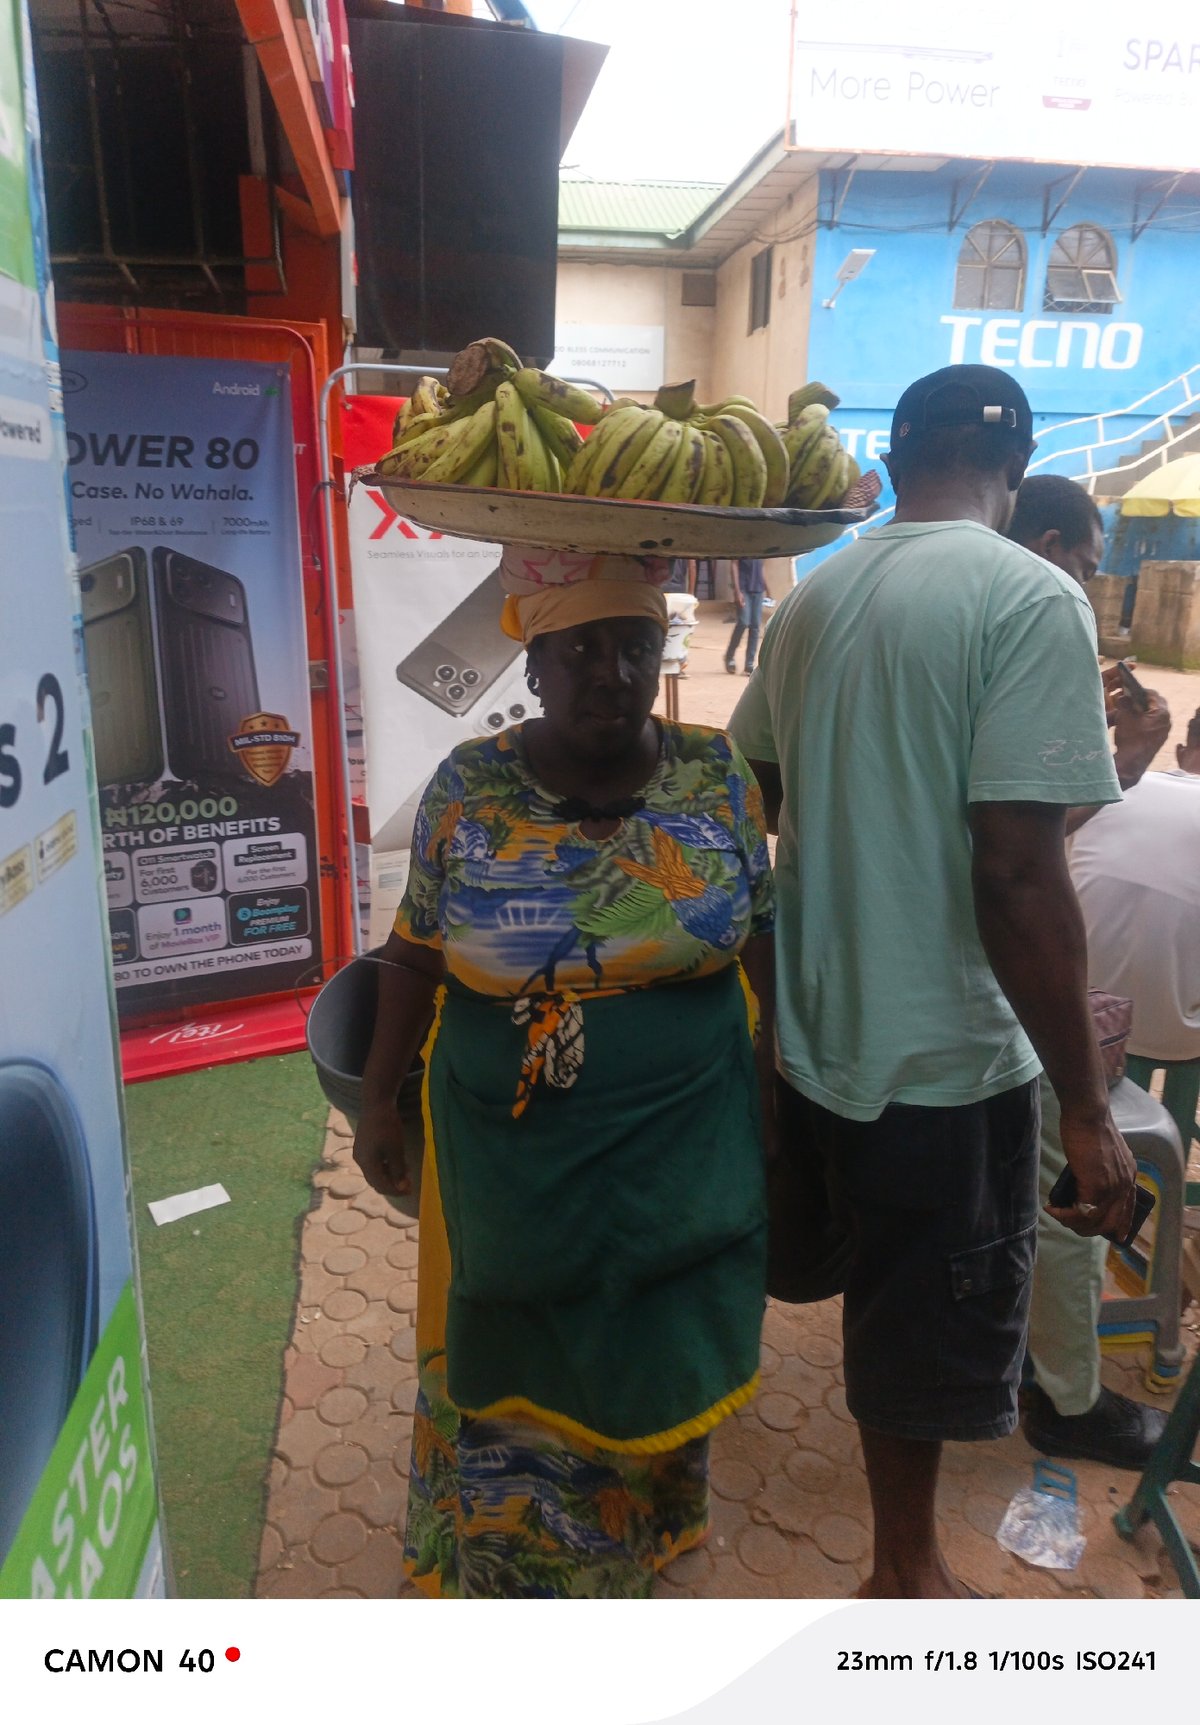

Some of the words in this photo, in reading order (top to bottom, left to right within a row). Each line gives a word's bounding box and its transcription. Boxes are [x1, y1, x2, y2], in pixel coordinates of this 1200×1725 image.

[810, 67, 891, 101] More
[907, 71, 1000, 108] Power
[940, 315, 1143, 369] TECNO
[212, 382, 260, 397] Android
[205, 437, 260, 470] 80
[72, 481, 128, 500] Case.
[135, 482, 164, 501] No
[171, 483, 254, 502] Wahala.
[130, 516, 156, 526] IP68
[158, 516, 167, 526] &
[169, 516, 184, 526] 69
[367, 550, 416, 559] Seamless
[417, 550, 450, 559] Visuals
[452, 550, 465, 559] for
[468, 551, 480, 559] an
[37, 672, 70, 786] 2
[234, 734, 272, 747] MIL-STD
[105, 797, 239, 827] ₦120,000
[149, 827, 179, 844] OF
[183, 817, 281, 841] BENEFITS
[157, 850, 214, 863] Smartwatch
[156, 867, 176, 875] first
[141, 875, 178, 888] 6,000
[141, 885, 190, 896] Customers
[145, 931, 172, 942] Enjoy
[181, 922, 222, 935] month
[243, 925, 268, 937] FOR
[268, 921, 297, 933] FREE
[134, 967, 151, 979] TO
[153, 963, 188, 976] OWN
[190, 958, 214, 969] THE
[217, 951, 261, 966] PHONE
[262, 945, 303, 960] TODAY
